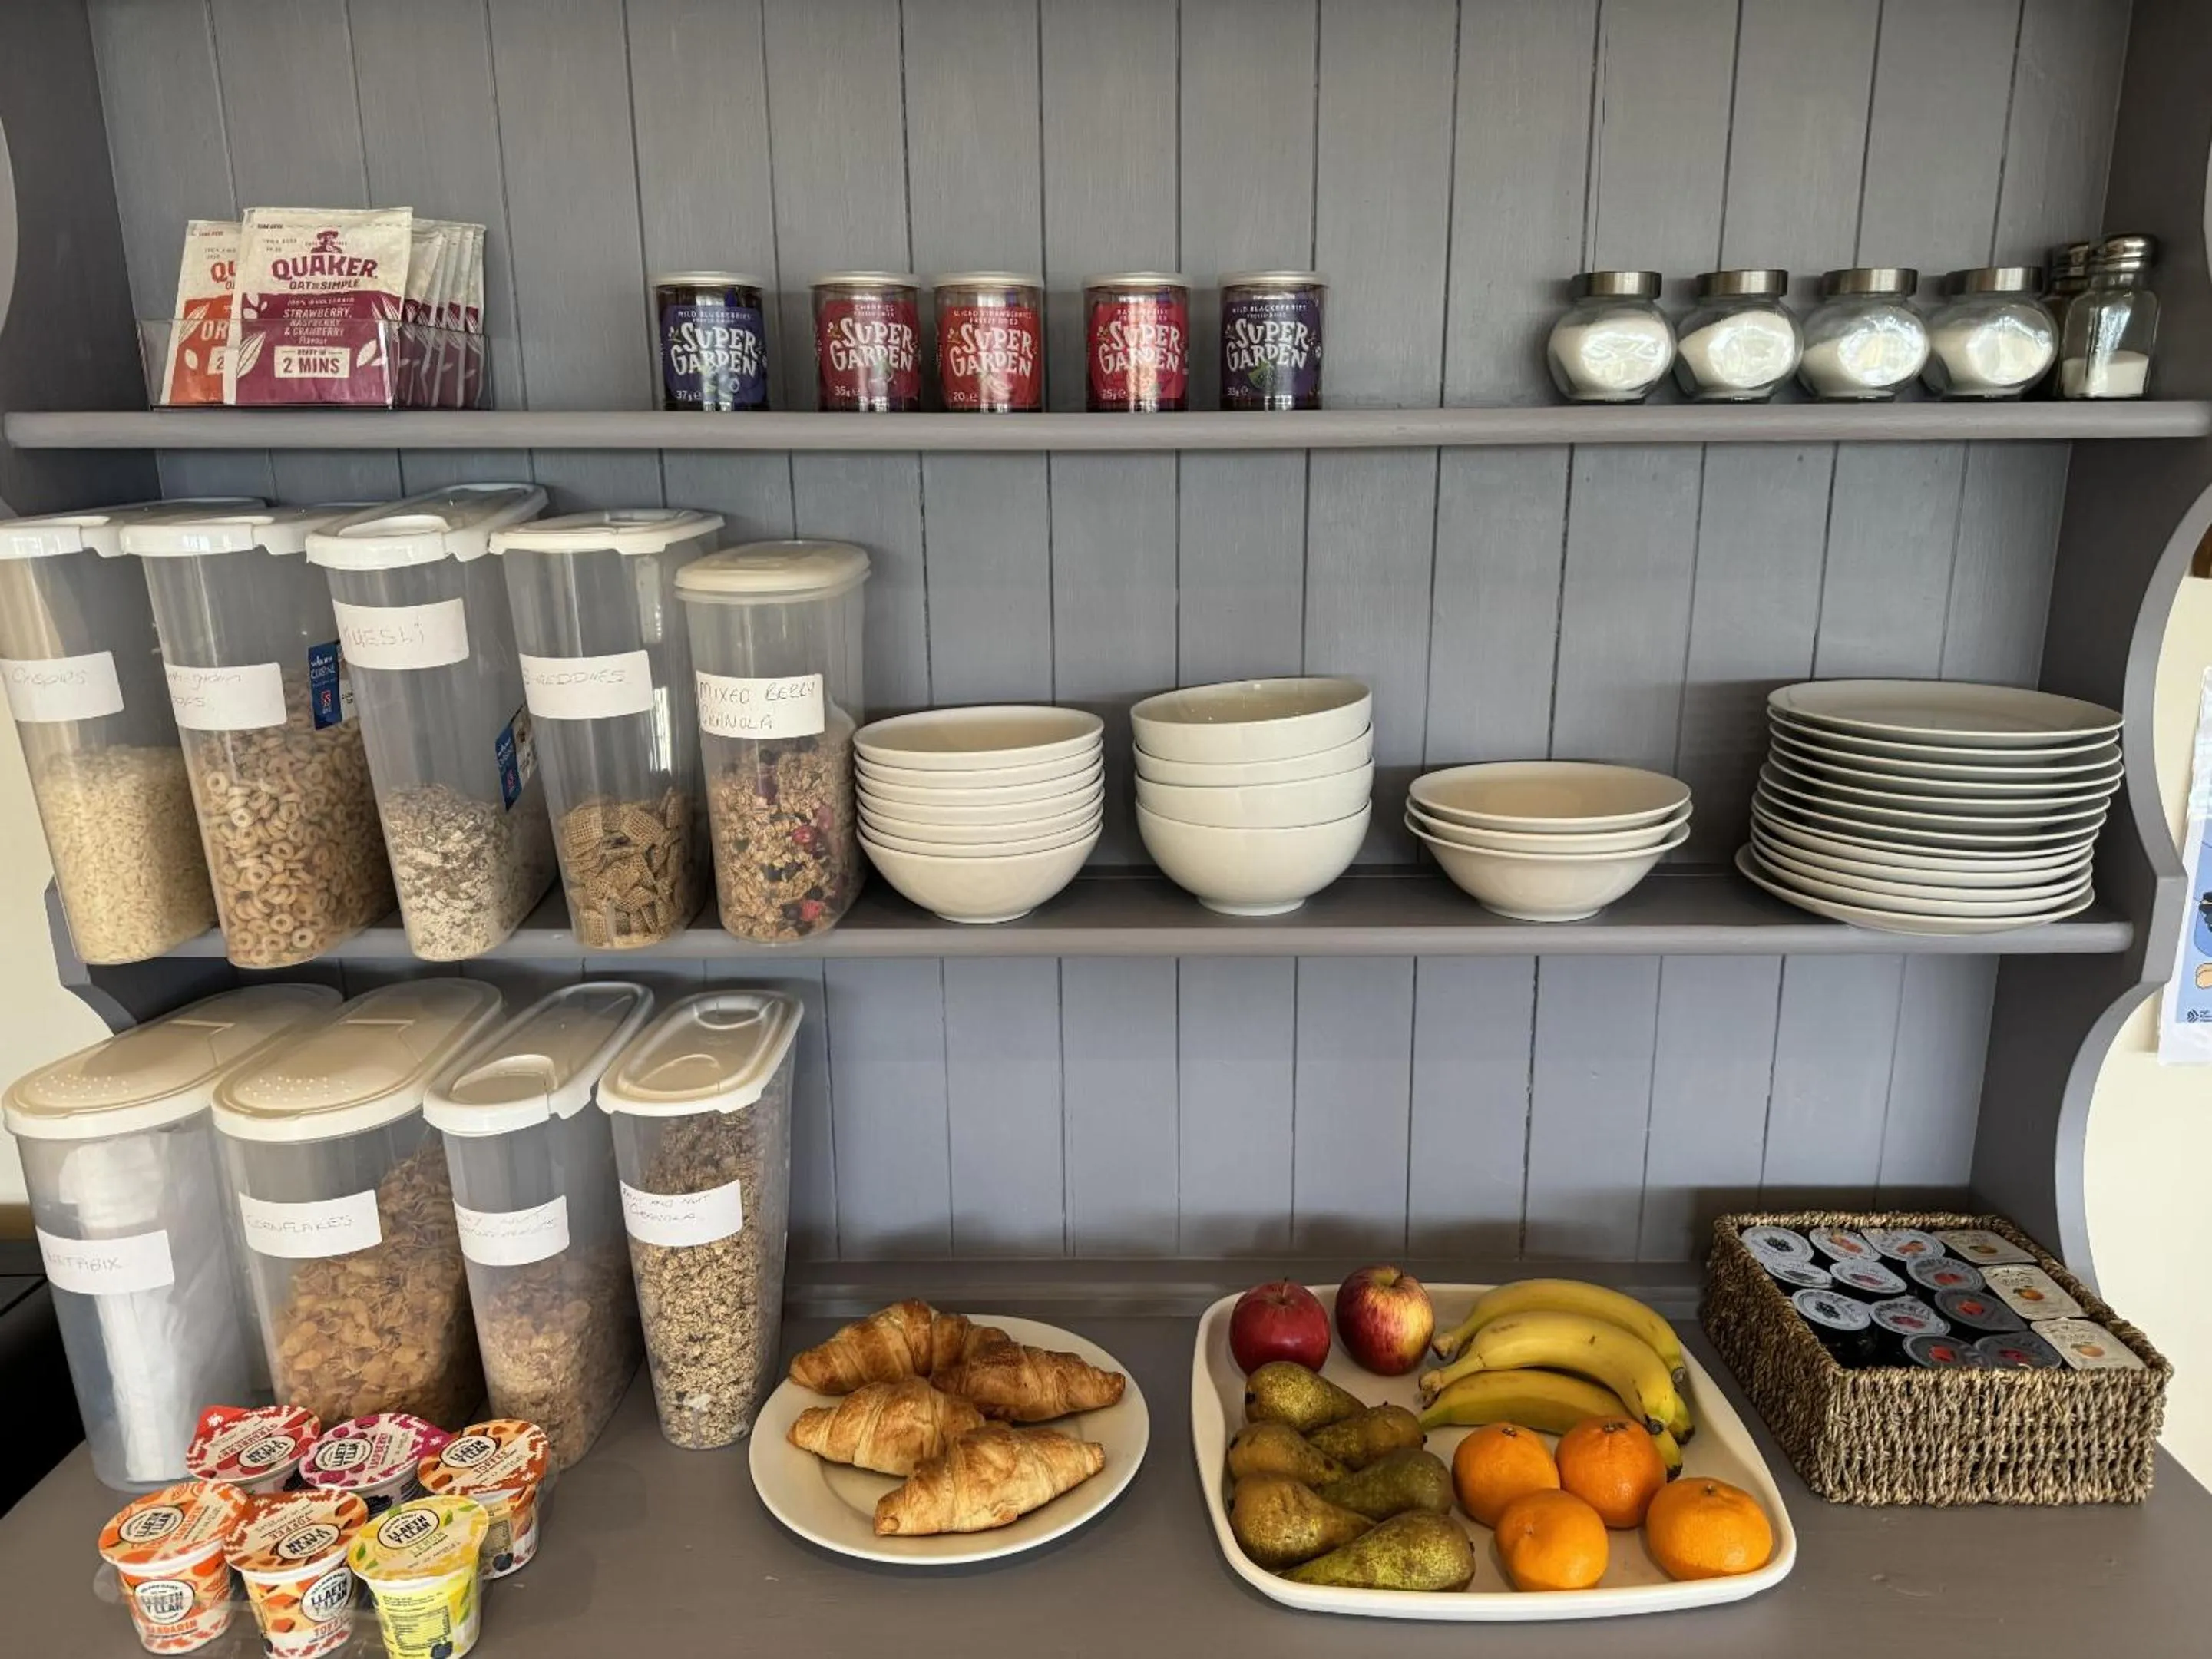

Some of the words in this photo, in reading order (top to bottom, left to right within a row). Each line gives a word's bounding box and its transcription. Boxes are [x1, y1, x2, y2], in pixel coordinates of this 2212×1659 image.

[271, 254, 379, 281] QUAKER
[289, 280, 312, 290] OAT
[319, 279, 360, 289] SIMPLE
[680, 322, 759, 360] SUPER
[839, 316, 914, 354] SUPER
[960, 322, 1033, 360] SUPER
[1109, 320, 1182, 355] SUPER
[1235, 317, 1310, 352] SUPER
[283, 357, 293, 374] 2
[299, 357, 340, 374] MINS
[670, 343, 758, 378] GARDEN
[829, 340, 913, 372] GARDEN
[949, 345, 1032, 378] GARDEN
[1098, 342, 1179, 374] GARDEN
[1227, 341, 1308, 372] GARDEN
[699, 681, 751, 705] MIXED
